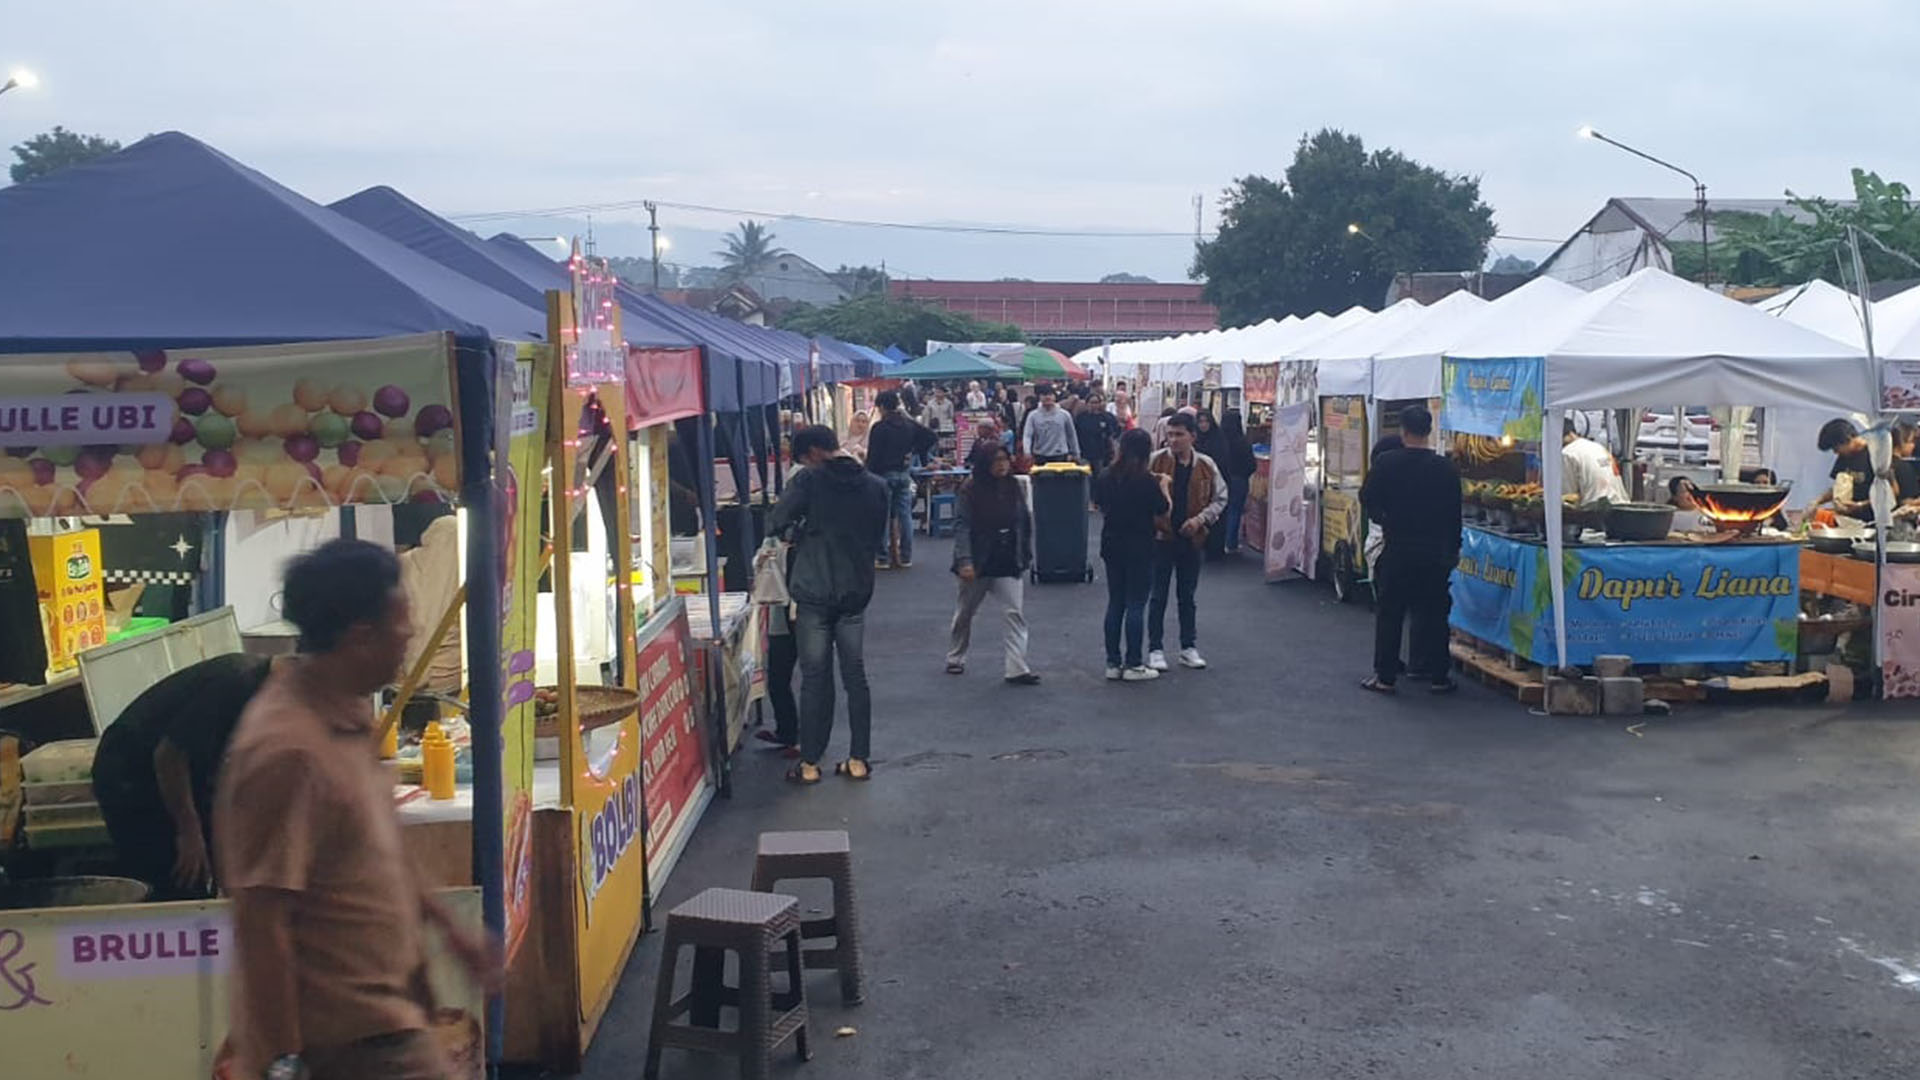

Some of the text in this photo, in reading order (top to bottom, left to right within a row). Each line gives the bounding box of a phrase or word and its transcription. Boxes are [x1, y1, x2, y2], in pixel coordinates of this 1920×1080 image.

[92, 405, 156, 430] UBI
[1578, 564, 1793, 611] Dapur Liana
[73, 928, 219, 963] BRULLE
